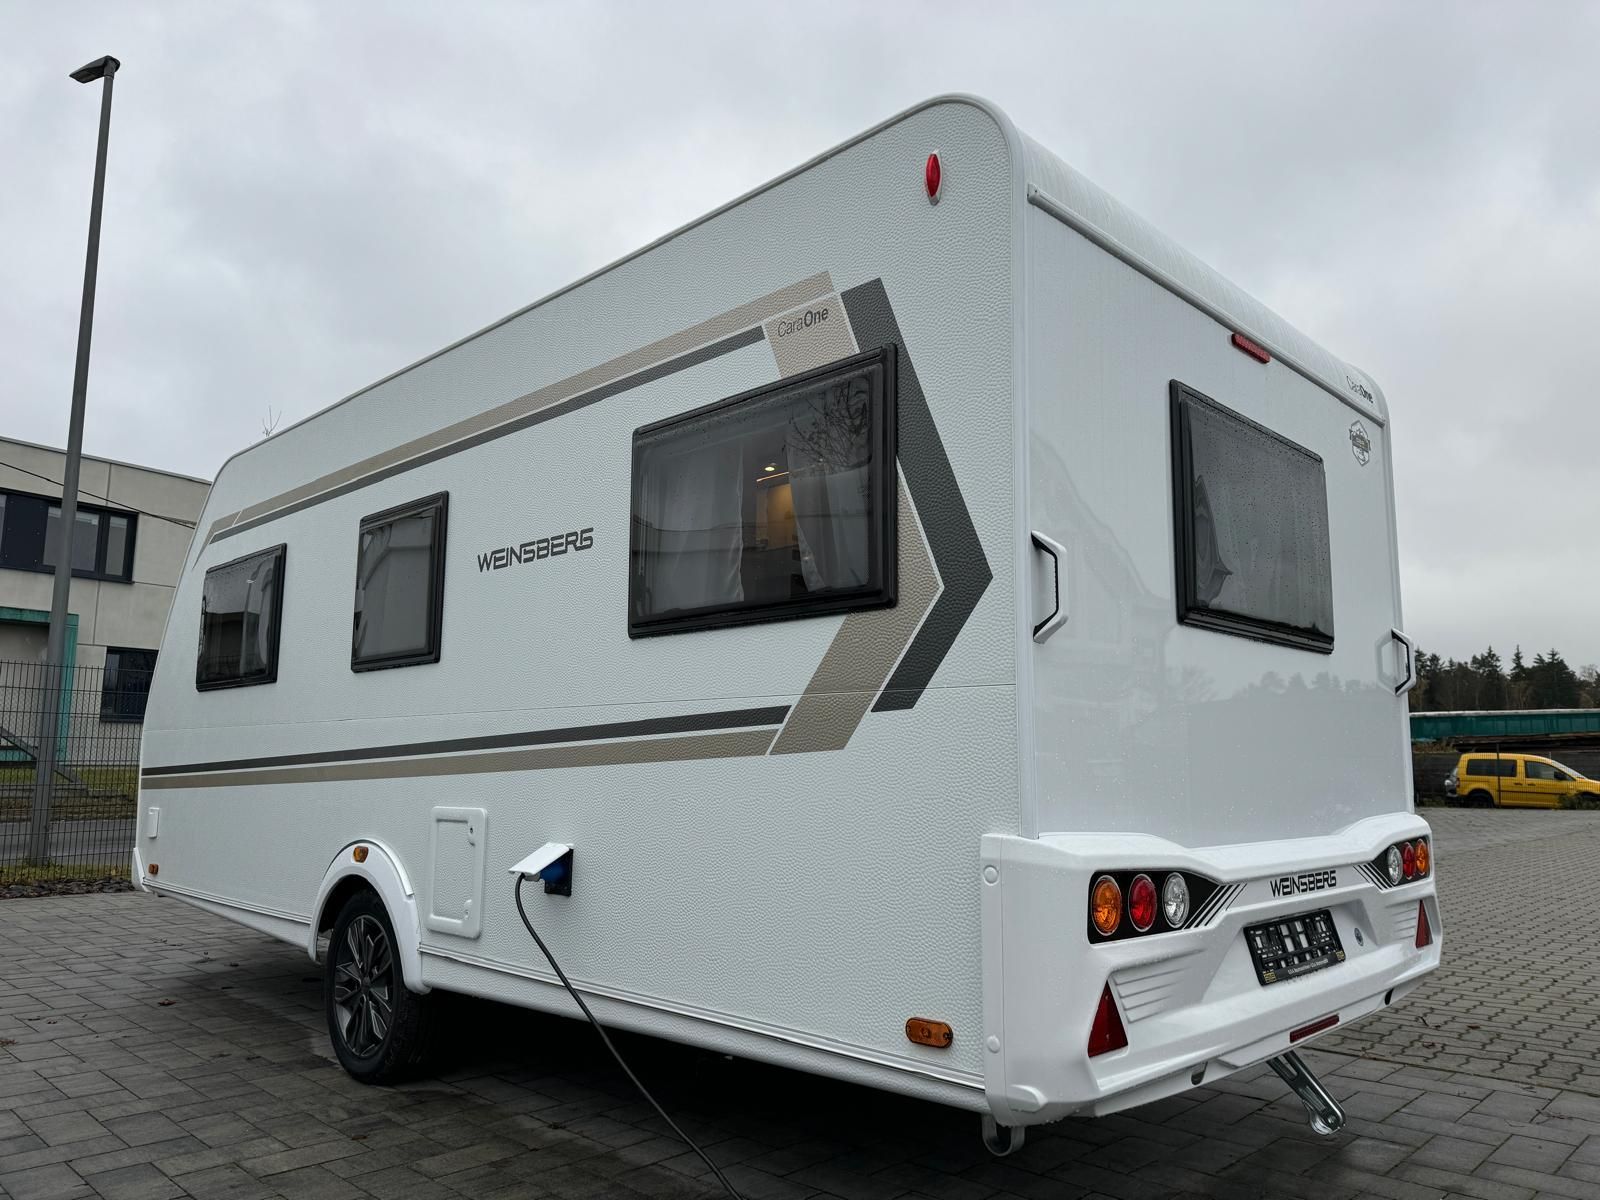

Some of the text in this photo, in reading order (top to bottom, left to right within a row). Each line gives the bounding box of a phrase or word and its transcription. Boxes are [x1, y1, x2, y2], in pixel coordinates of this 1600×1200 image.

[777, 308, 829, 337] CaraOne
[477, 527, 594, 573] WEINSBERG
[1270, 869, 1337, 898] WEINSBERG
